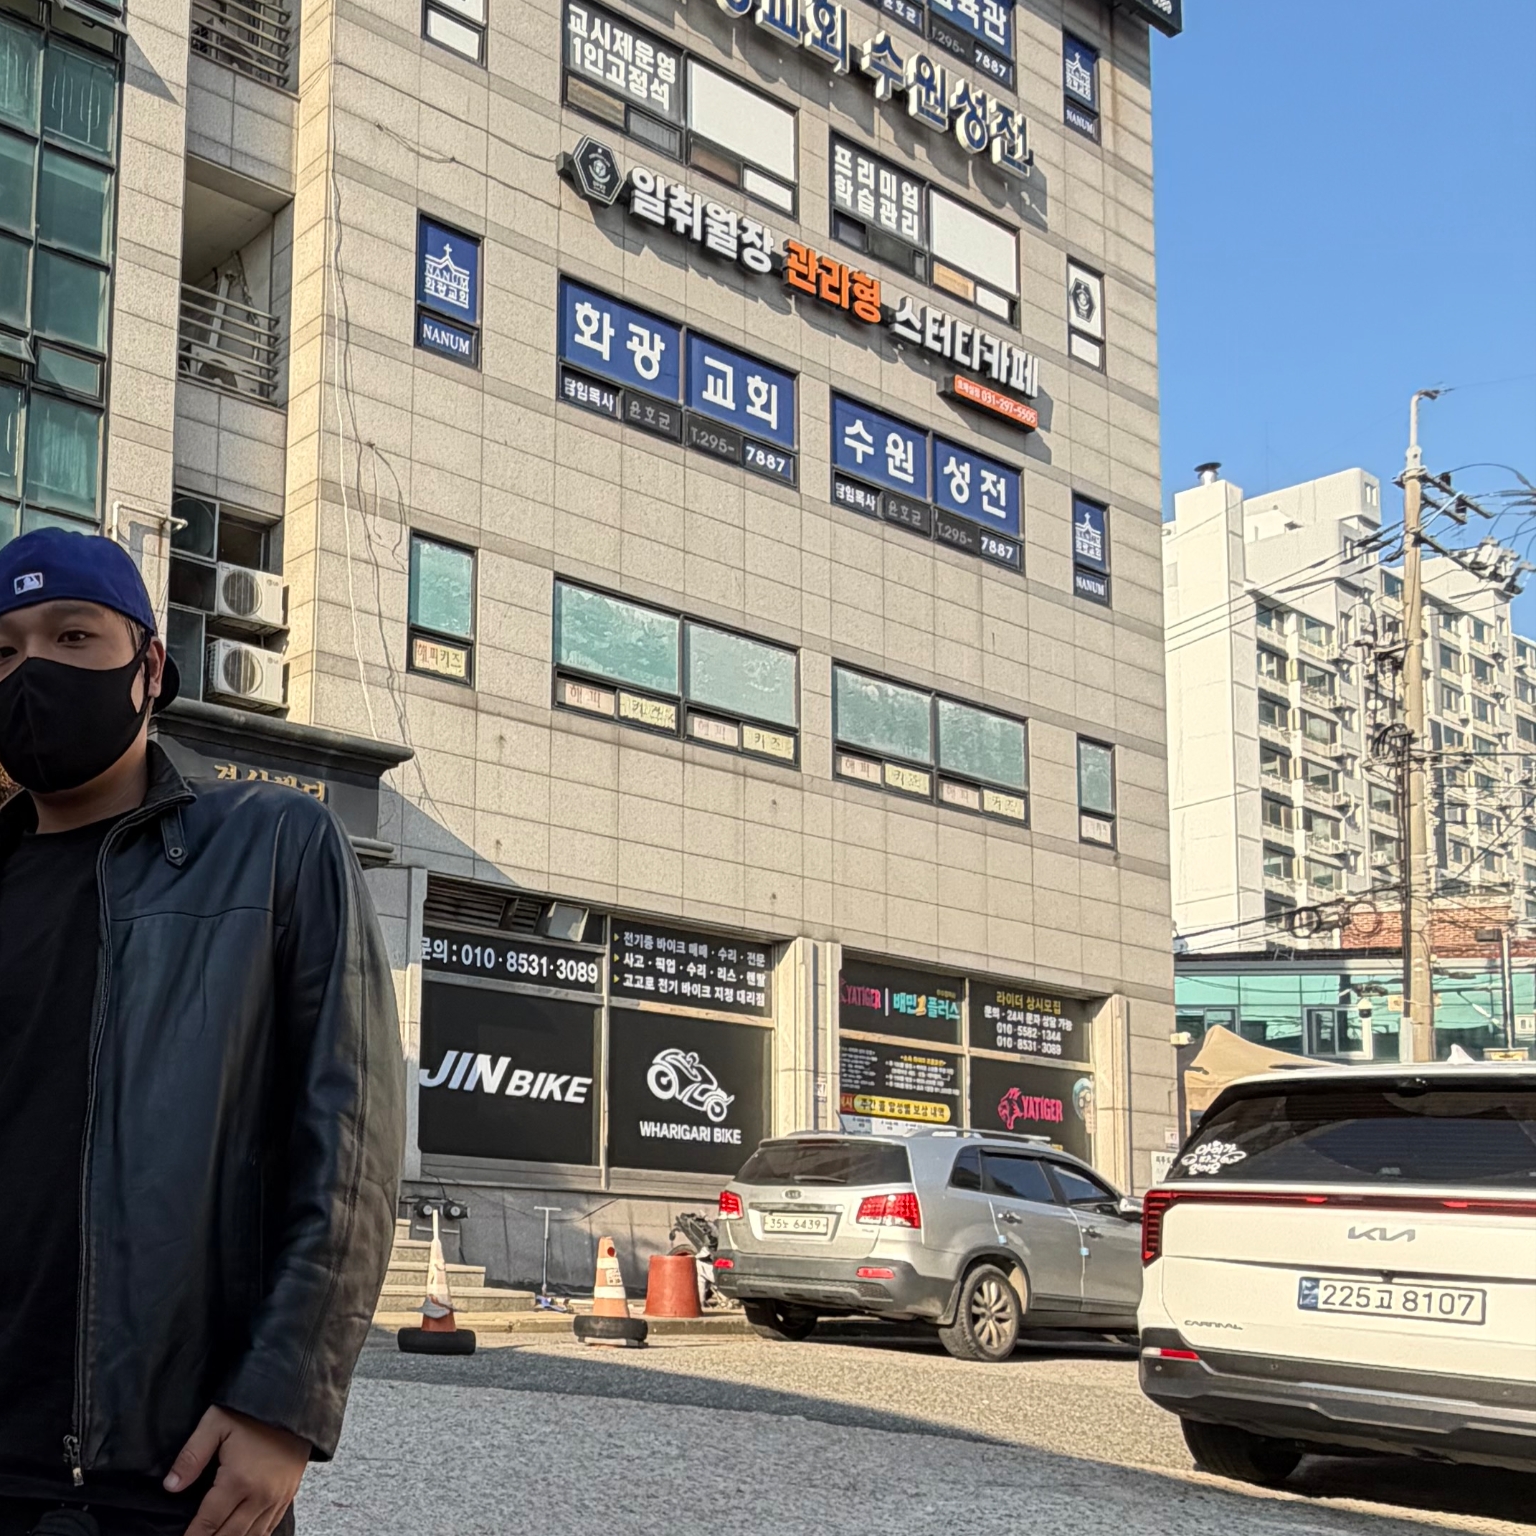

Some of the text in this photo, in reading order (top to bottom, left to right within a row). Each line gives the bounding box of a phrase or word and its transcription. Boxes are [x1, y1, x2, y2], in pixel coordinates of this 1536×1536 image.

[934, 0, 1007, 46] 육관
[567, 3, 676, 85] 교시제운영
[573, 37, 670, 112] 1인고정석
[975, 49, 1007, 77] 7887
[718, 0, 1031, 178] 교회 수원성전
[834, 144, 918, 213] 프리미엄
[834, 174, 919, 241] 학습관리
[425, 263, 469, 289] NANUM
[425, 277, 469, 302] 화광교회
[630, 166, 775, 274] 일취월장
[787, 239, 882, 323] 관리형
[892, 296, 1039, 399] 스터디카페
[422, 323, 470, 355] NANUM
[574, 302, 778, 430] 화광 교회
[564, 377, 614, 412] 담임목사
[745, 445, 786, 473] 7887
[844, 419, 1007, 519] 수원 성전
[980, 536, 1014, 559] 7887
[1075, 576, 1105, 597] NANUM
[623, 952, 645, 969] 사고
[686, 962, 707, 979] 수리
[717, 966, 738, 983] 리스
[656, 937, 686, 955] 바이크
[717, 947, 737, 964] 수리
[746, 951, 766, 968] 전문
[623, 973, 766, 1007] 고고로 전기 바이크 지정 대리점
[996, 991, 1062, 1015] 라이더 상시모집
[419, 1050, 593, 1105] JIN BIKE
[1021, 1095, 1063, 1123] YATIGER
[639, 1120, 742, 1145] WHARIGARI BIKE
[793, 1219, 821, 1230] 6439
[1402, 1290, 1476, 1317] 8107
